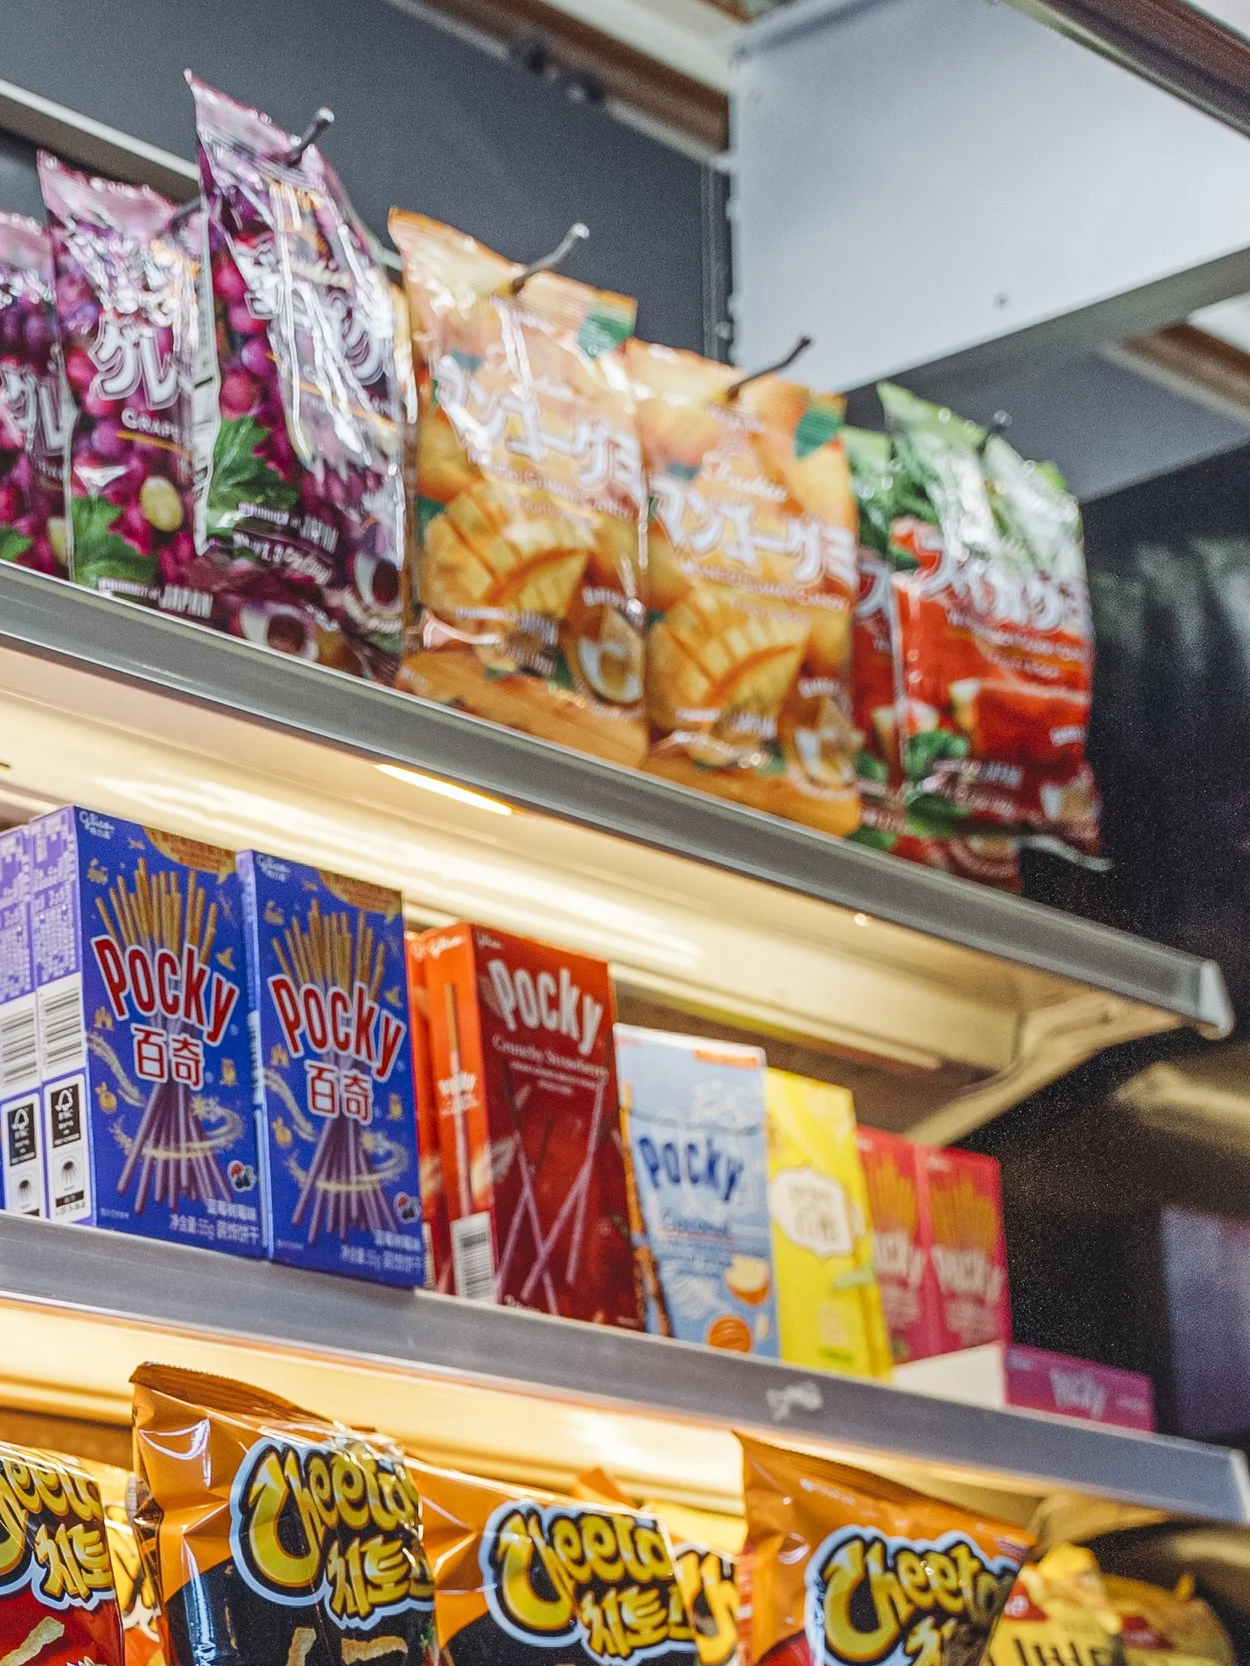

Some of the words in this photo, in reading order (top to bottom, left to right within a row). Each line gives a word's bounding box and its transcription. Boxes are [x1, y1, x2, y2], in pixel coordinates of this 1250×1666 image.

[91, 934, 240, 1047] Pocky
[268, 973, 406, 1082] Pocky
[488, 958, 604, 1058] Pocky
[131, 1023, 205, 1090] 百奇
[304, 1060, 373, 1127] 百奇
[638, 1136, 745, 1203] Pocky
[35, 1523, 113, 1600] 치토
[249, 1441, 418, 1587] Cheeto
[498, 1510, 674, 1631] Cheeto
